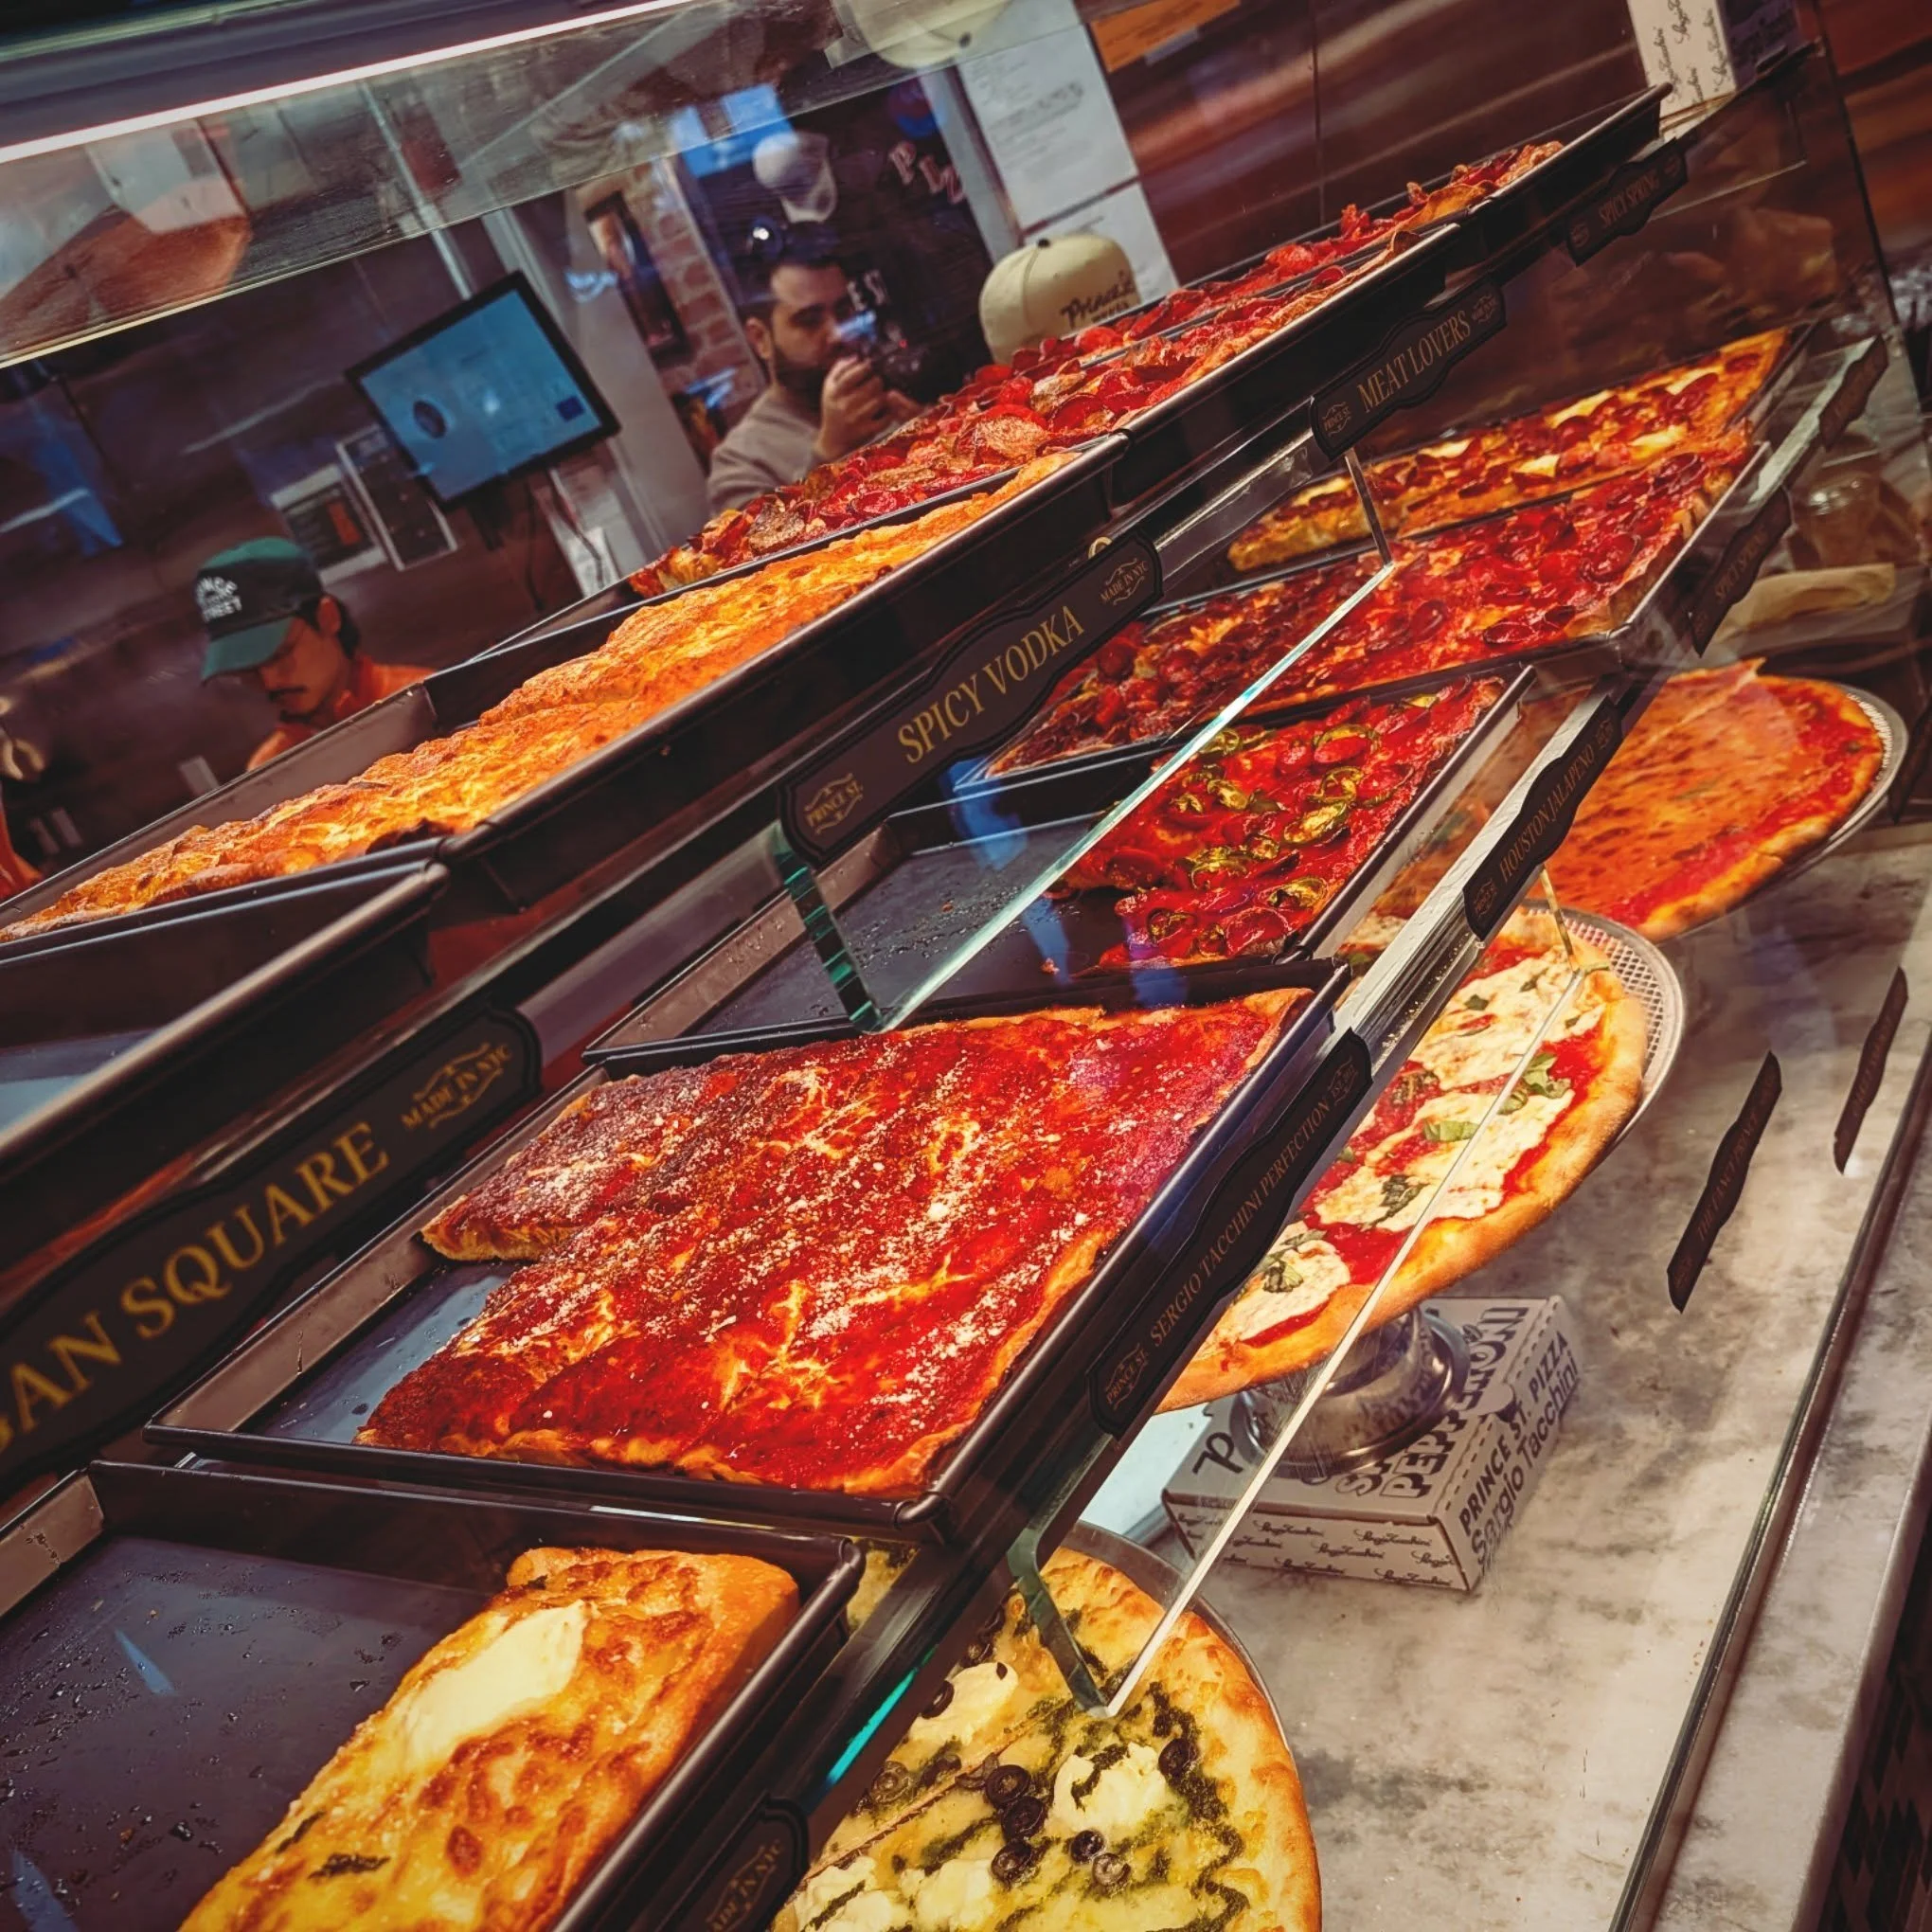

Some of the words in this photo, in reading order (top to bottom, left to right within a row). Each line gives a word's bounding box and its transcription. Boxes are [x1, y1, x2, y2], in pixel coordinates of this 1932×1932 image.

[1356, 353, 1410, 414] MEAT
[1406, 310, 1472, 376] LOVERS
[897, 673, 985, 764] SPICY
[982, 605, 1084, 696] VODKA
[1498, 808, 1550, 885] HOUSTON
[456, 1070, 478, 1092] IN
[119, 1121, 390, 1339] SQUARE
[1149, 1277, 1203, 1349] SERGIO
[1199, 1192, 1263, 1279] TACCHINI
[1258, 1099, 1332, 1200] PERFECTION
[1458, 1434, 1512, 1538] PRINCE
[1508, 1400, 1532, 1440] ST.
[1528, 1330, 1568, 1404] PIZZA
[1516, 1349, 1579, 1469] Tacchini
